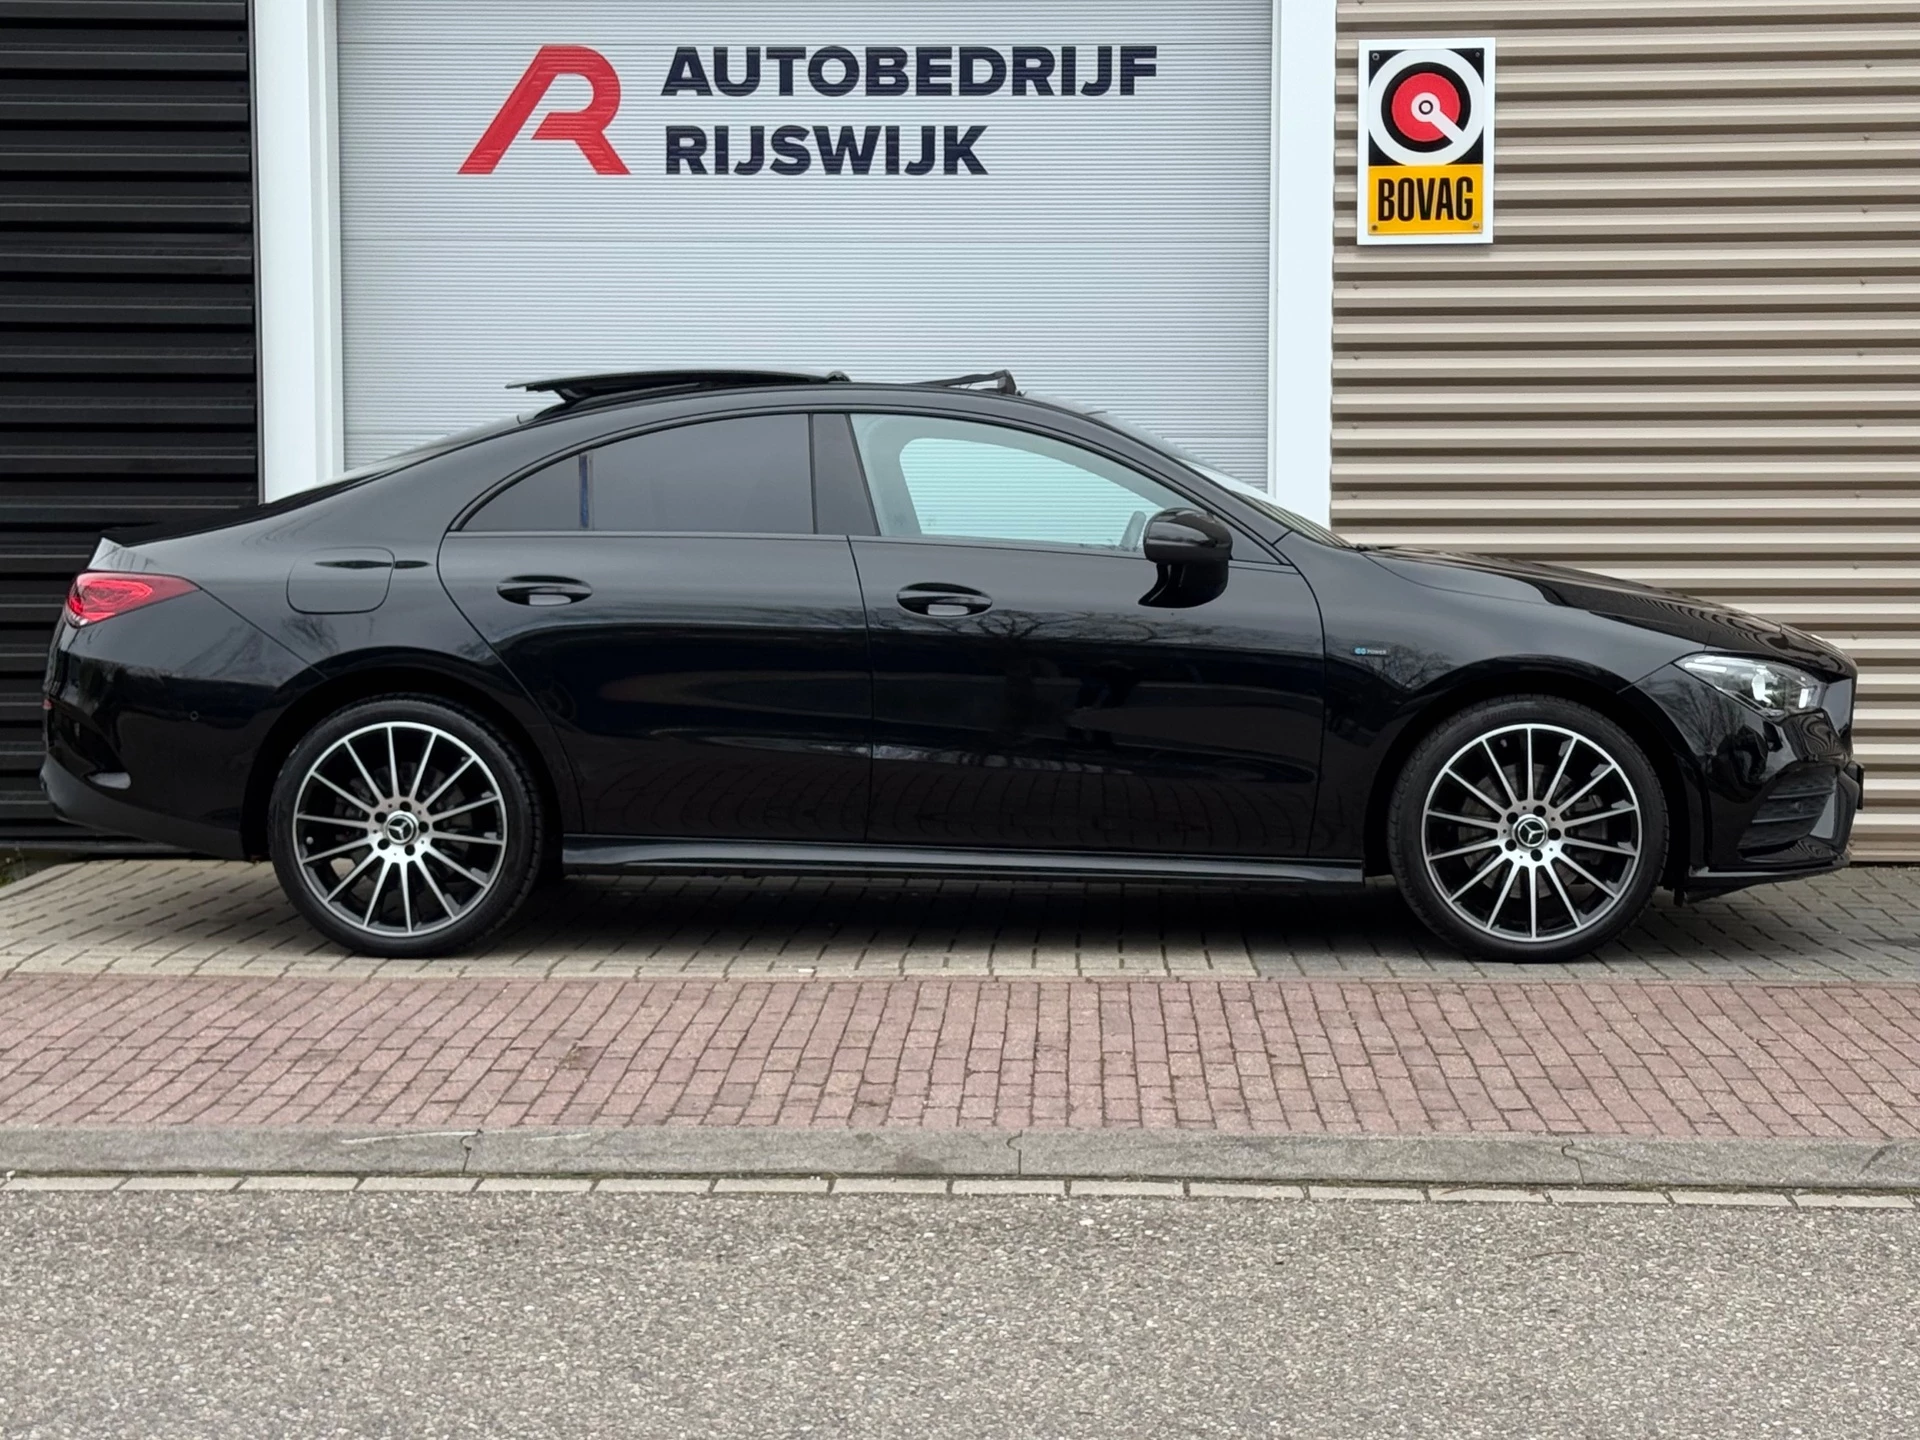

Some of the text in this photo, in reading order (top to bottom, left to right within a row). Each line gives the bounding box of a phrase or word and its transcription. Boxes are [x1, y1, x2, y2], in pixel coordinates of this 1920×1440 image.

[661, 45, 1157, 97] AUTOBEDRIJF
[665, 124, 988, 176] RIJSWIJK
[1378, 176, 1473, 222] BOVAG
